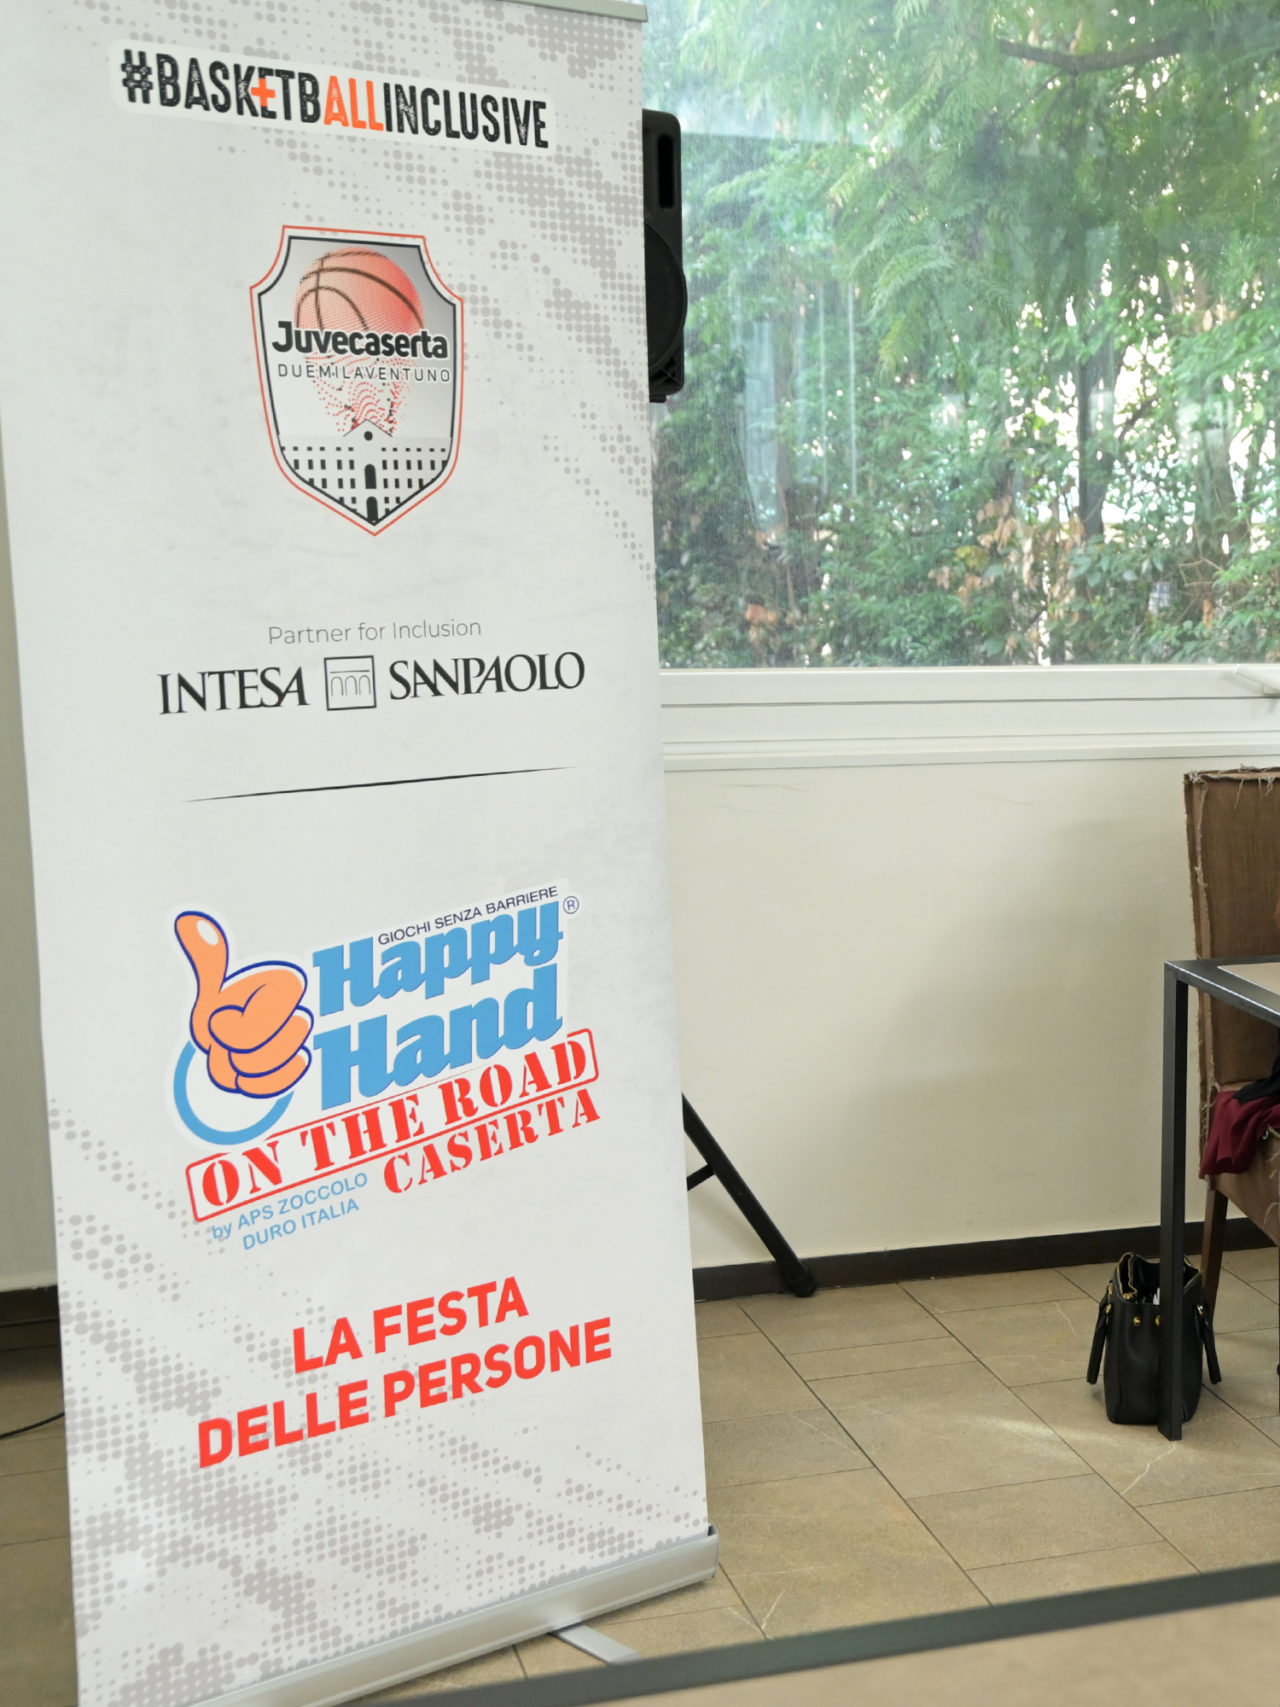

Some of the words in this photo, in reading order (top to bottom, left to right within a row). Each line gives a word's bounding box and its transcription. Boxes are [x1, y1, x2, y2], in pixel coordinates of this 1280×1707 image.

[121, 48, 549, 148] #BASKETBALLINCLUSIVE
[272, 321, 448, 358] Juvecaserta
[278, 364, 450, 382] DUEMILAVENTUNO
[268, 624, 352, 645] Partner
[358, 621, 386, 641] for
[393, 619, 482, 640] Inclusion
[157, 666, 310, 715] INTESA
[388, 651, 586, 700] SANPAOLO
[378, 921, 431, 945] GIOCHI
[434, 906, 482, 929] SENZA
[485, 886, 558, 914] BARRIERE
[312, 901, 564, 1017] Happy
[312, 963, 563, 1111] Hand
[201, 1140, 283, 1206] ON
[300, 1093, 425, 1171] THE
[438, 1040, 588, 1126] ROAD
[383, 1088, 601, 1193] CASERTA
[211, 1223, 233, 1240] by
[237, 1205, 274, 1230] APS
[278, 1172, 368, 1215] ZOCCOLO
[242, 1219, 297, 1250] DURO
[301, 1197, 360, 1229] ITALIA
[293, 1317, 363, 1374] LA
[372, 1276, 530, 1354] FESTA
[198, 1380, 370, 1469] DELLE
[383, 1317, 612, 1417] PERSONE
